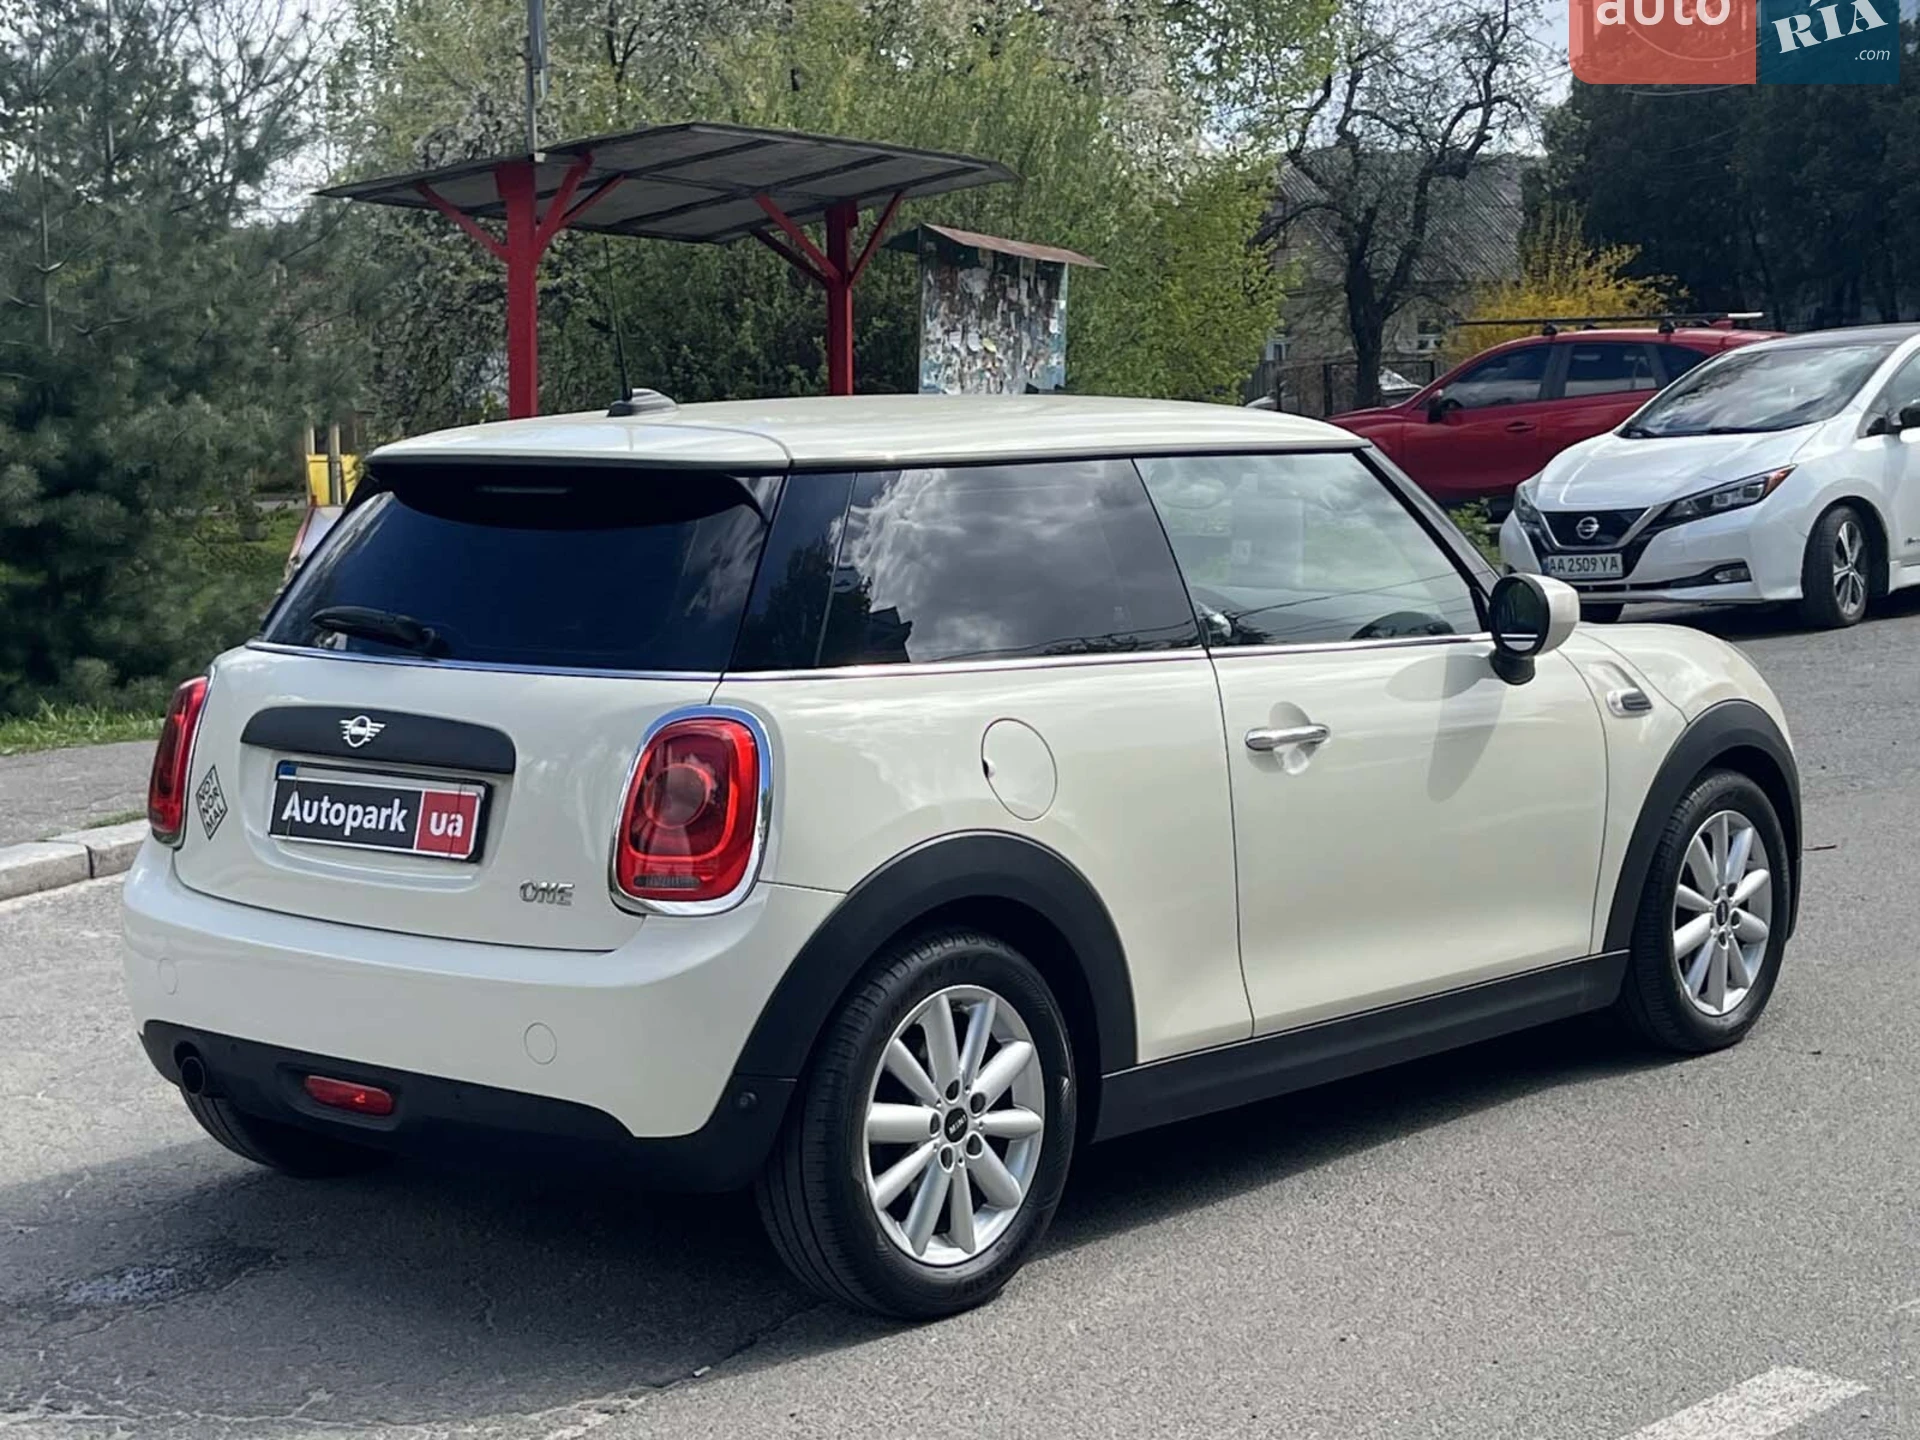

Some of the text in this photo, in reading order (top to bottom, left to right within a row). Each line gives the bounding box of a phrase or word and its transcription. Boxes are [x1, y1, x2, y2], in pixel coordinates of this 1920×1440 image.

[1550, 556, 1618, 573] AA 2509 YA
[199, 772, 214, 805] NOT
[202, 786, 220, 818] NOR
[206, 803, 224, 832] MAL
[281, 790, 465, 838] Autopark ua
[519, 880, 576, 907] ONE
